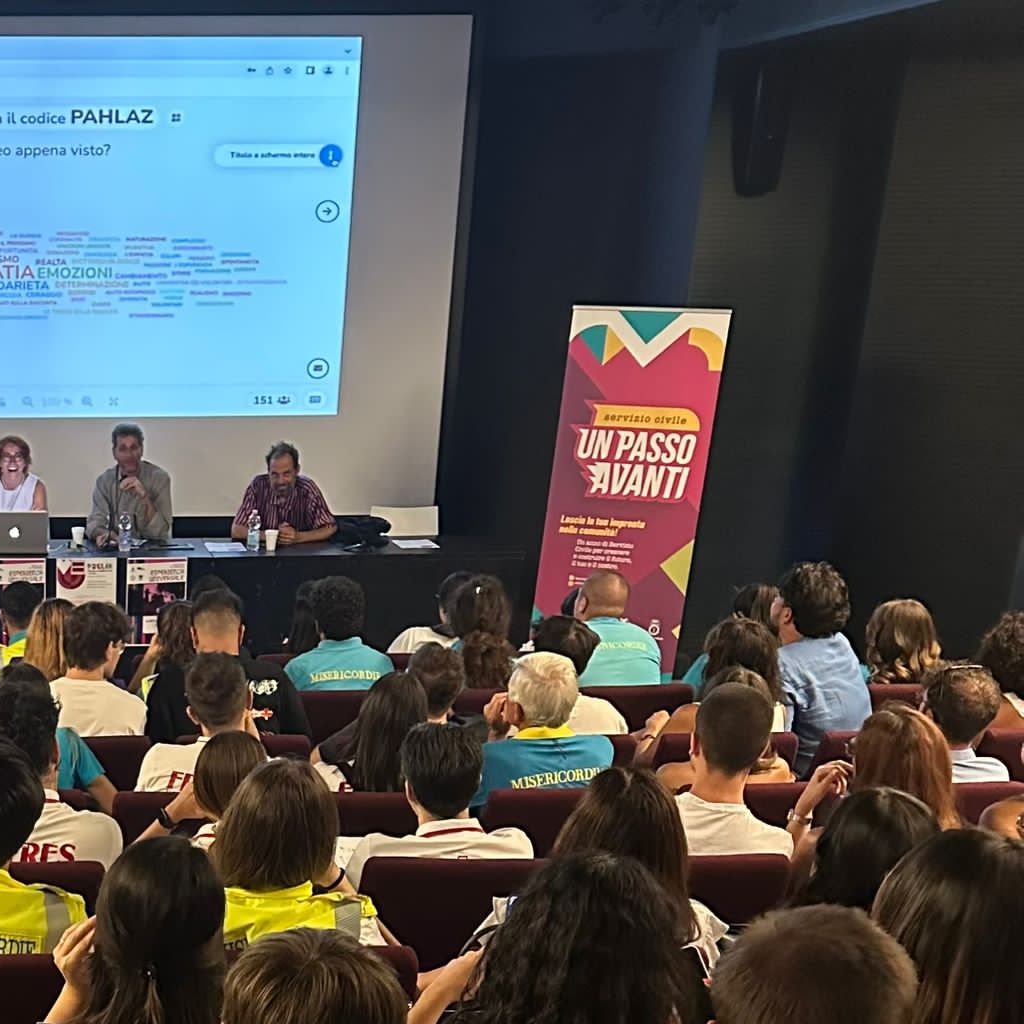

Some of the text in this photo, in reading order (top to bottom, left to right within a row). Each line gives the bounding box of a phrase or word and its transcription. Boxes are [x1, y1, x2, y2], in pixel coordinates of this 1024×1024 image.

[7, 111, 15, 124] il
[20, 111, 66, 124] codice
[71, 109, 153, 124] PAHLAZ
[15, 147, 66, 158] appena
[71, 143, 111, 156] visto?
[36, 258, 66, 266] REALTA
[37, 266, 113, 279] EMOZIONI
[254, 395, 273, 405] 151
[604, 412, 687, 425] servizio civile
[577, 428, 697, 465] UN PASSO
[587, 461, 690, 500] AVANTI
[595, 517, 609, 526] tua
[609, 517, 646, 529] impronta
[511, 767, 601, 790] MISERICORDI
